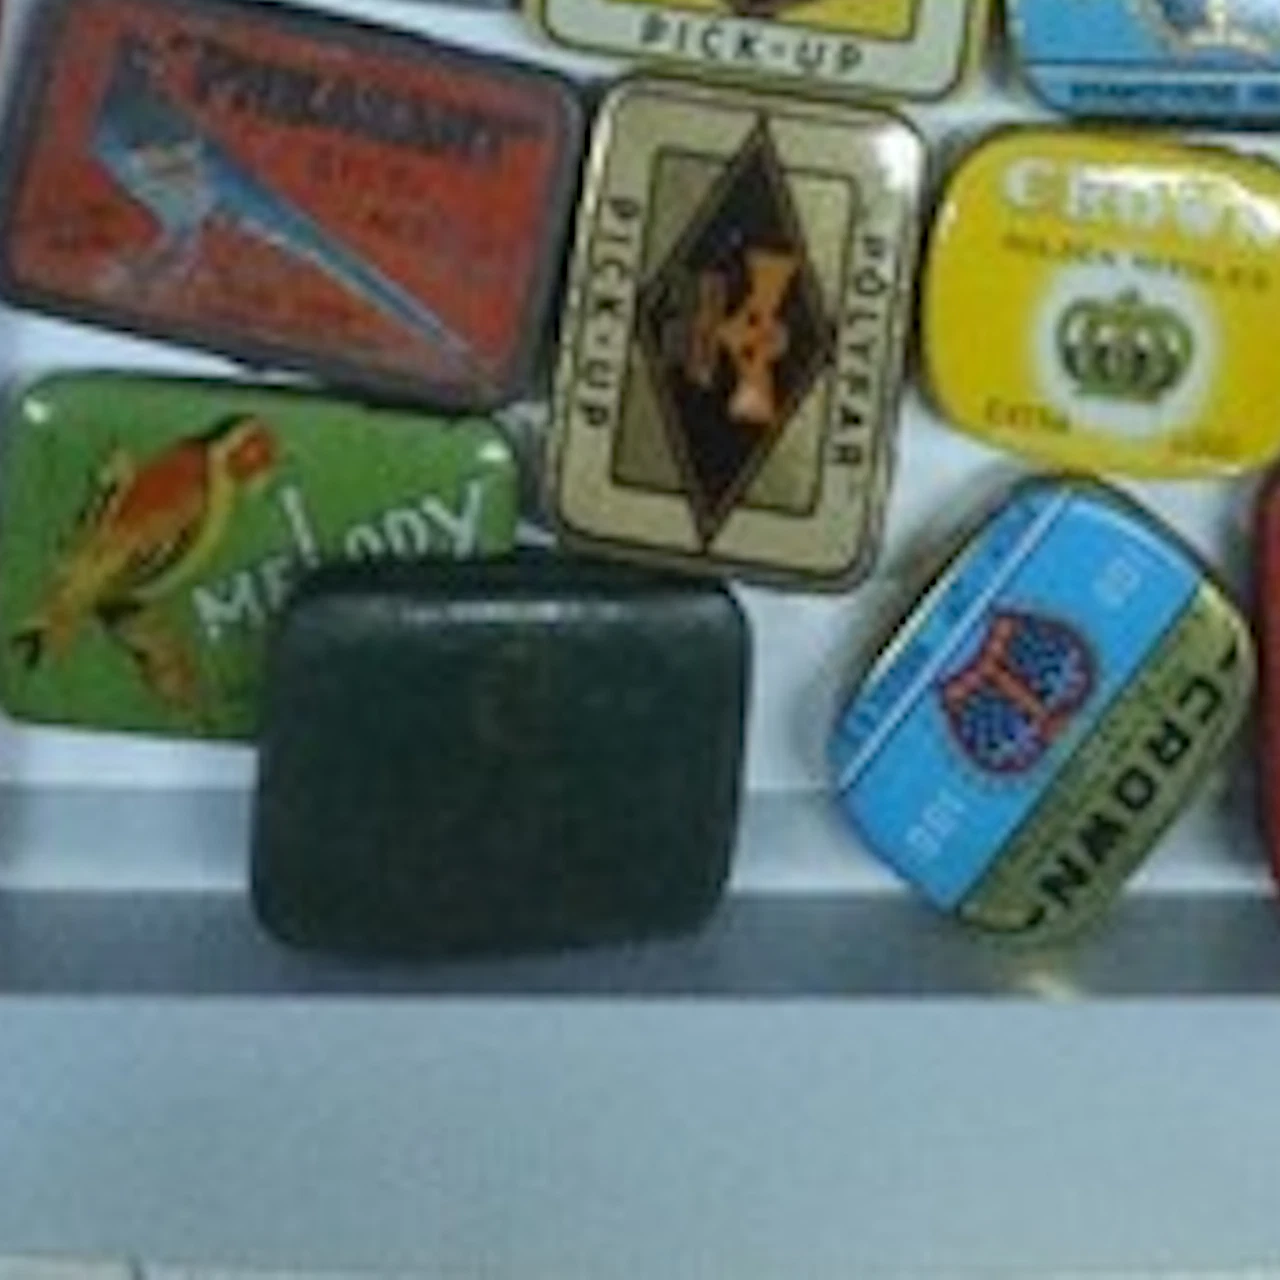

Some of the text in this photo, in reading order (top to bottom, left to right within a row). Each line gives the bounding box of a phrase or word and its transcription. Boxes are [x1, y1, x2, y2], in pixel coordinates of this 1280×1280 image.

[640, 10, 866, 78] PICK-UP
[582, 196, 644, 430] PICK-UP
[828, 236, 892, 470] POLYFAR
[1038, 674, 1224, 908] CROWN
